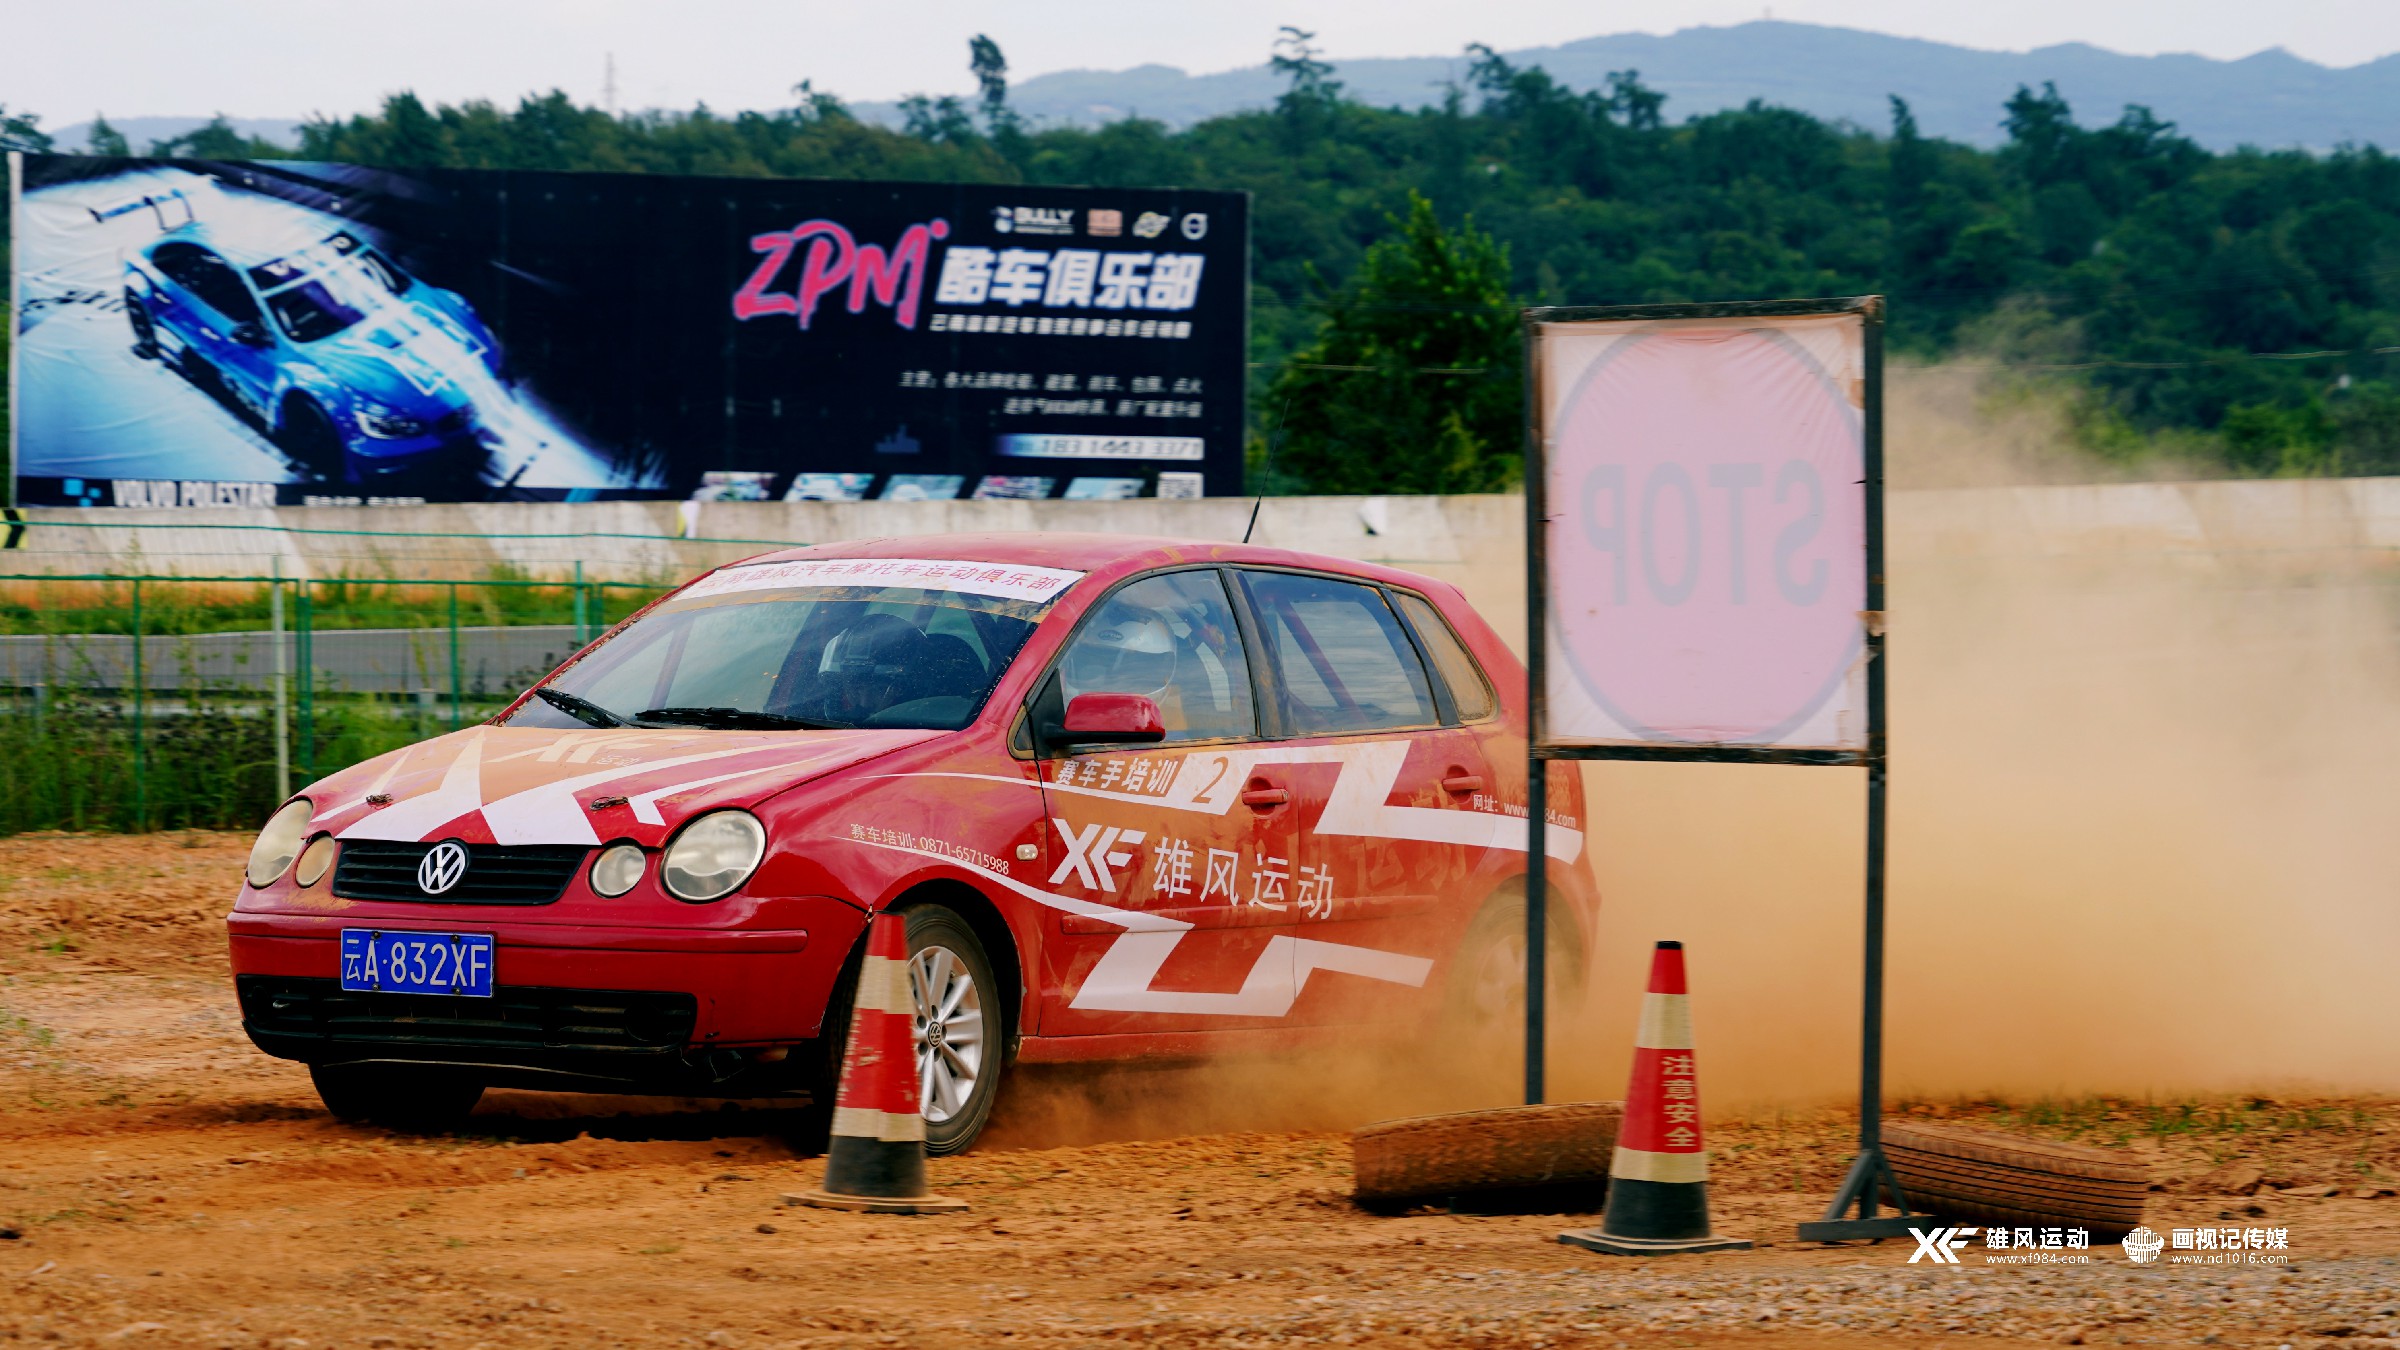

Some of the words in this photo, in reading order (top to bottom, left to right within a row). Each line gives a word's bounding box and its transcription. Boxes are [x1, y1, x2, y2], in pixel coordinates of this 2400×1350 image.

[733, 218, 949, 331] ZPM
[935, 246, 1205, 311] 酷车俱乐部
[1055, 757, 1179, 798] 赛车手培训
[1192, 756, 1230, 805] 2
[1152, 836, 1335, 920] 雄风运动
[1660, 1054, 1698, 1147] 注意安全
